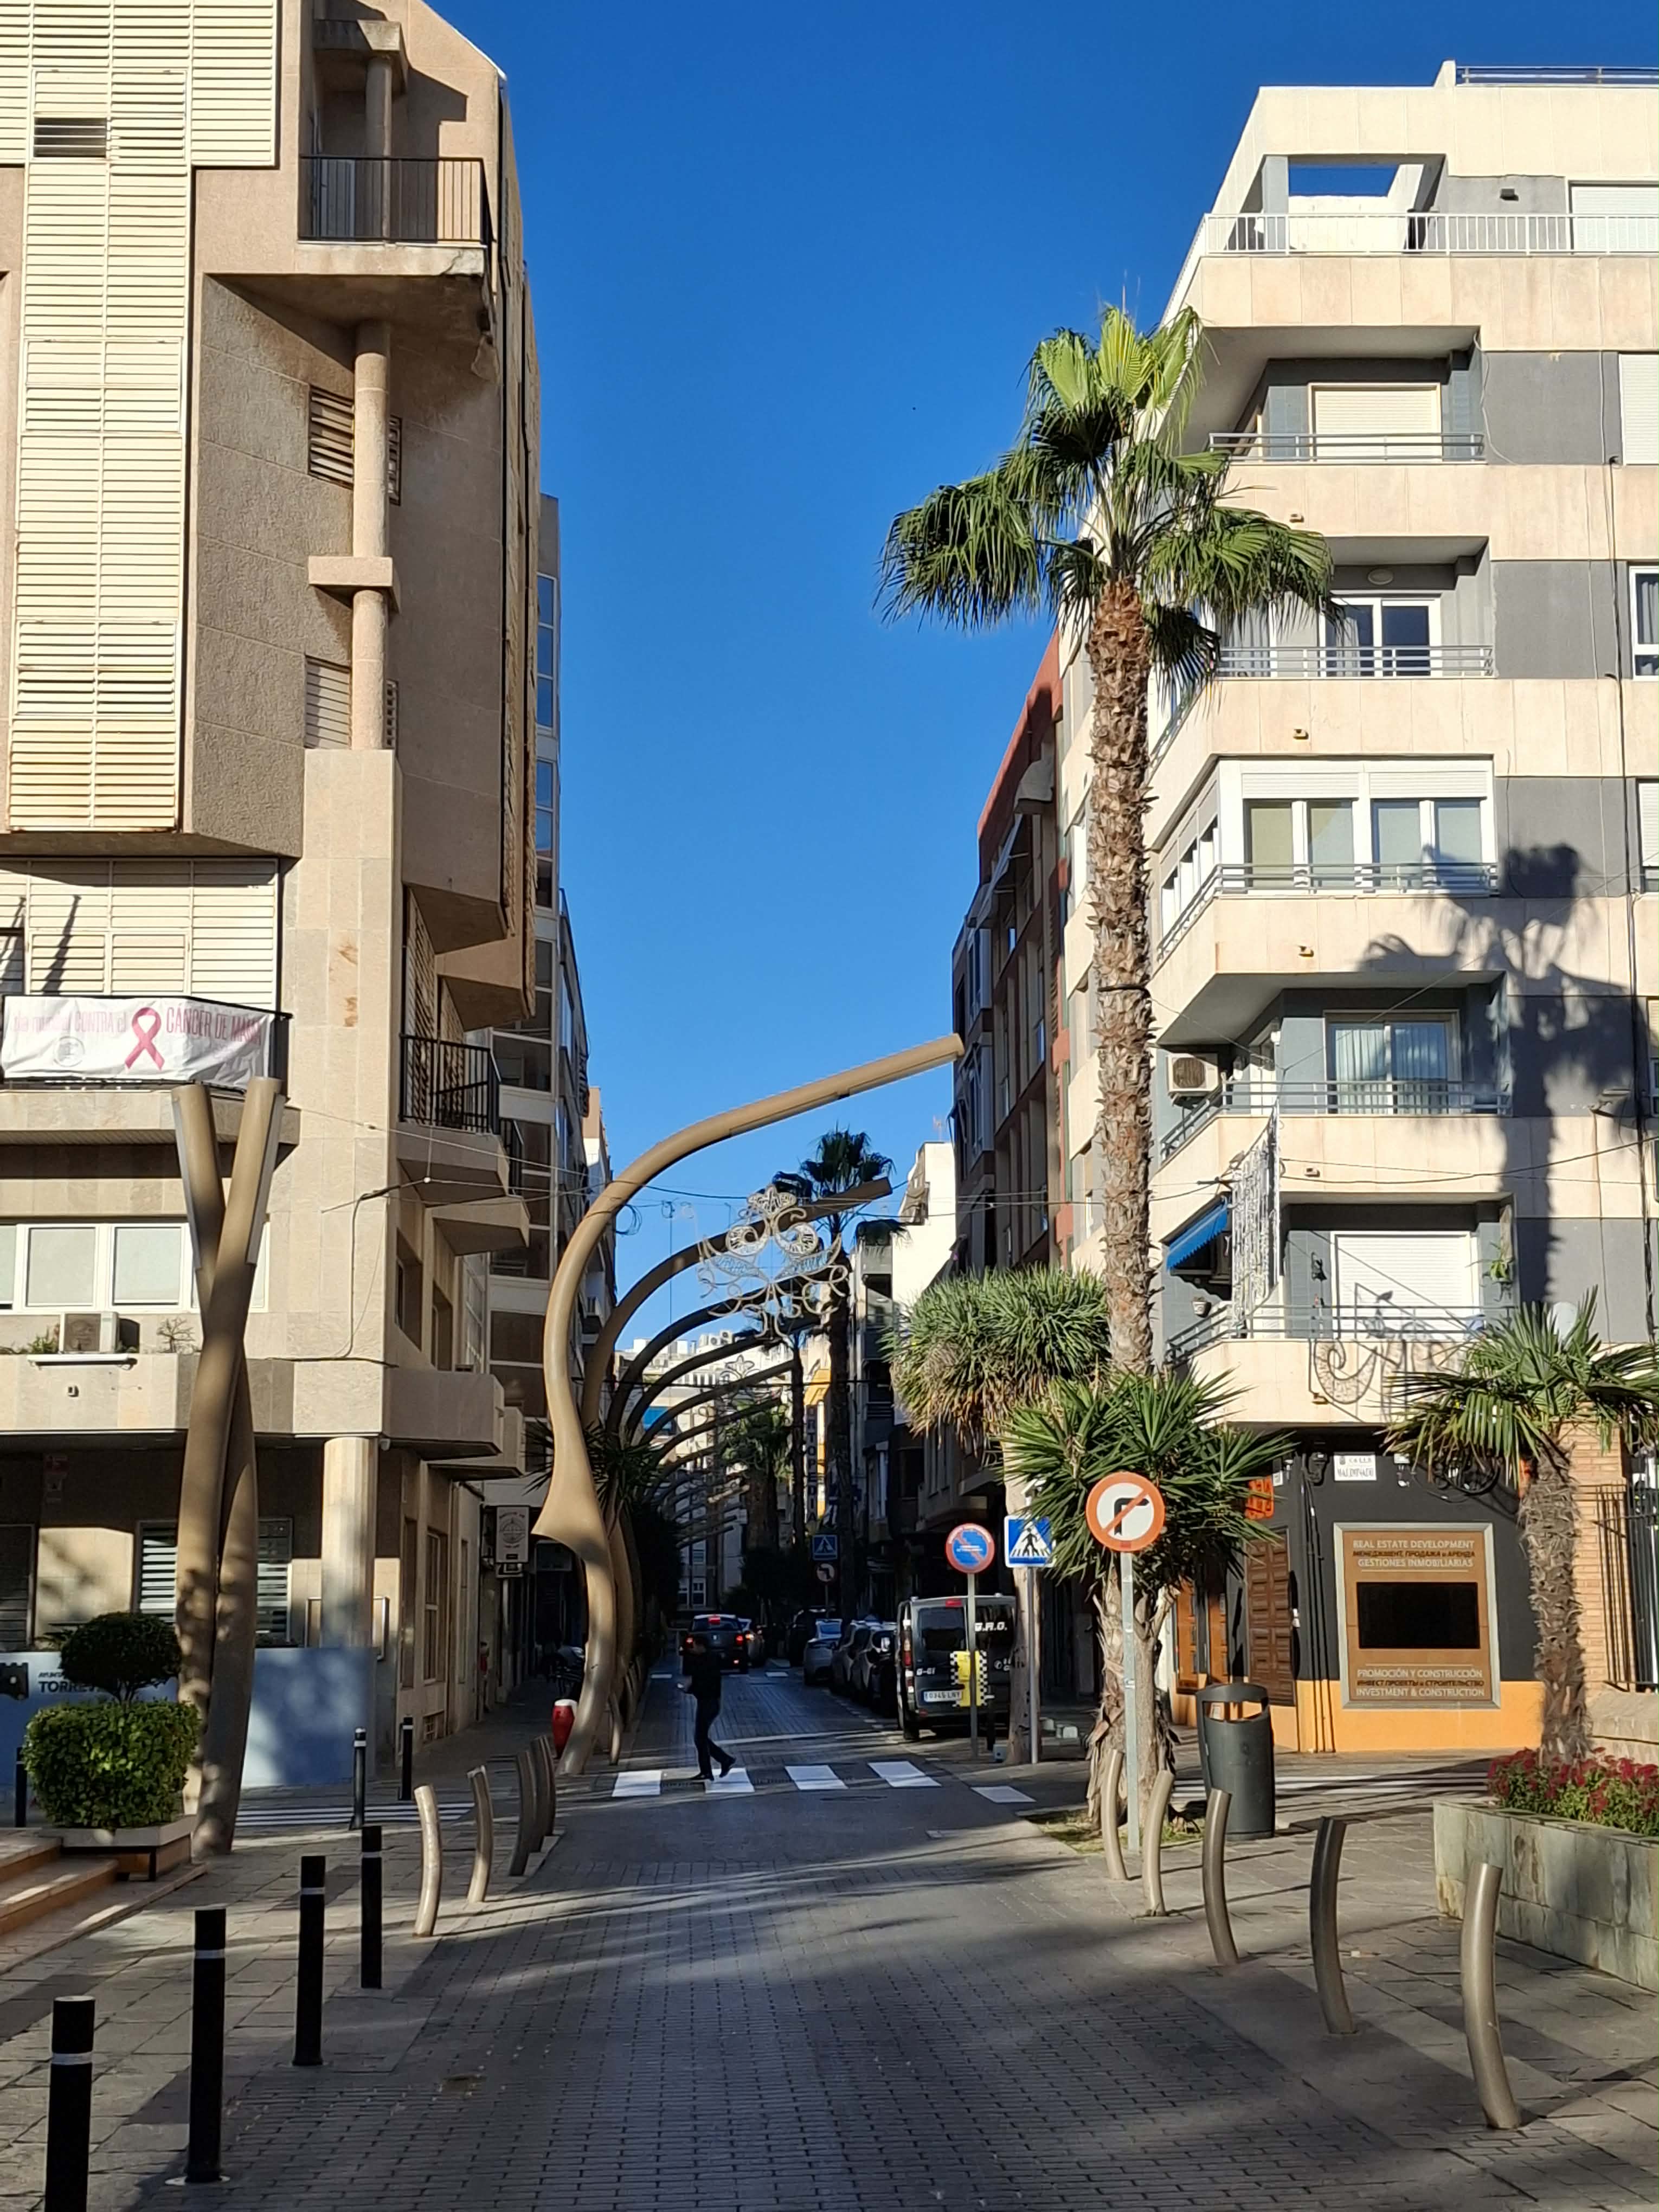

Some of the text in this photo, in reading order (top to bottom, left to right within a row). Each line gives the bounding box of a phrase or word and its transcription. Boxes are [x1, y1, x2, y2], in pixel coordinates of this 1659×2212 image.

[166, 1005, 212, 1037] CÁNCER
[215, 1013, 228, 1040] DE
[807, 1407, 816, 1521] ORTOPEDIA
[1353, 1540, 1475, 1549] REAL ESTATE DEVELOPMENT
[1358, 1558, 1474, 1567] GESTIONES INMOBILIARIAS
[1357, 1668, 1483, 1678] PROMOCIÓN Y CONSTRUCCIÓN
[1356, 1688, 1484, 1696] INVESTMENT & CONSTRUCTION
